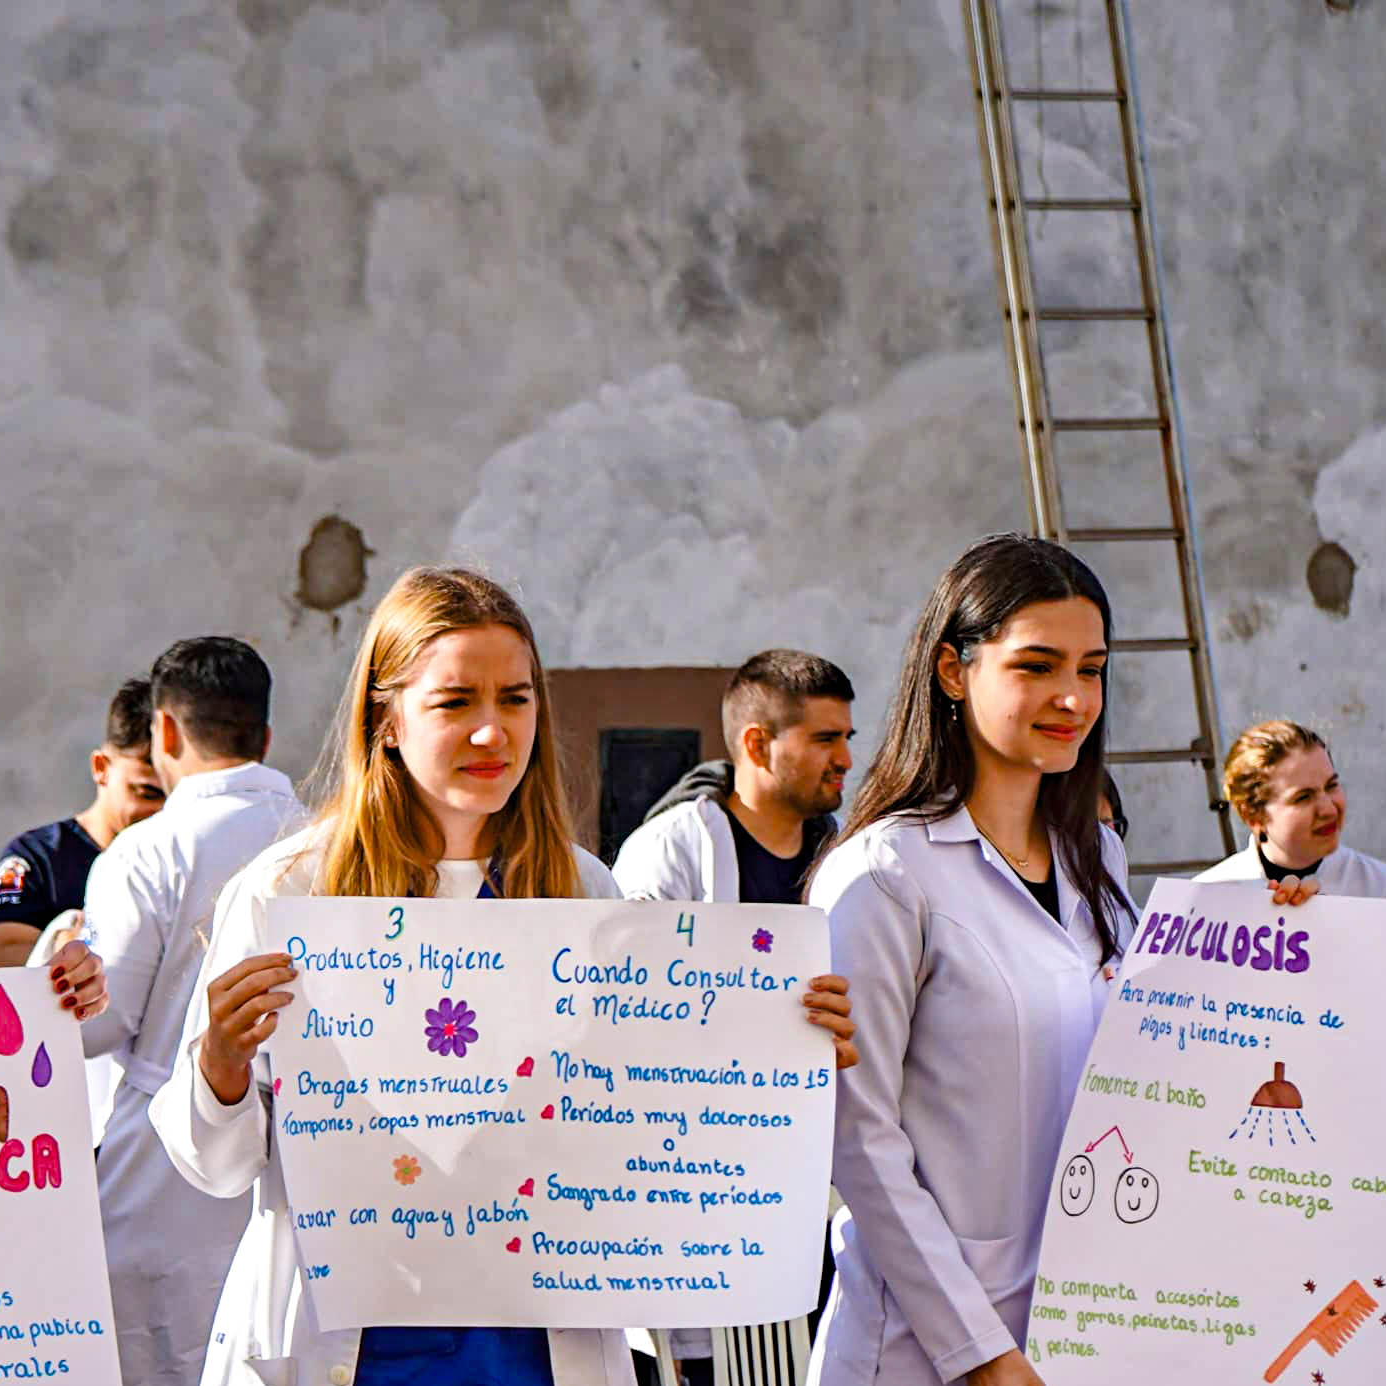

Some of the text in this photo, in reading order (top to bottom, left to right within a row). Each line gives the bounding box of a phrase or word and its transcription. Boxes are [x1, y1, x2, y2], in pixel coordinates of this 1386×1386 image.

[384, 907, 404, 940] 3
[676, 911, 696, 948] 4
[420, 942, 506, 990] Higiene
[551, 946, 799, 991] Cuando Consultar
[383, 977, 396, 1006] y
[555, 993, 576, 1016] el
[1118, 979, 1346, 1029] Para prevenir la presencia de
[301, 1007, 375, 1040] Alivio
[1177, 1026, 1187, 1051] y
[297, 1070, 369, 1109] Bragas
[582, 1058, 614, 1093] hay
[751, 1072, 767, 1088] a
[772, 1068, 800, 1089] los
[804, 1068, 830, 1090] 15
[1143, 1079, 1161, 1102] el
[1166, 1081, 1207, 1109] baño
[368, 1112, 419, 1136] copas
[560, 1095, 793, 1136] Períodos muy dolorosos
[625, 1155, 746, 1177] abundantes
[1188, 1149, 1238, 1176] Evite
[547, 1172, 637, 1211] Sangrado
[699, 1184, 785, 1213] períodos
[1233, 1187, 1334, 1220] a cabeza
[293, 1207, 337, 1230] avar
[349, 1207, 378, 1226] con
[391, 1206, 440, 1240] agua
[441, 1207, 455, 1238] y
[532, 1231, 664, 1261] Preocupación
[741, 1237, 765, 1256] la
[1061, 1279, 1139, 1303] comparta
[1032, 1302, 1067, 1322] como
[28, 1316, 105, 1348] pubica
[1028, 1337, 1041, 1363] y
